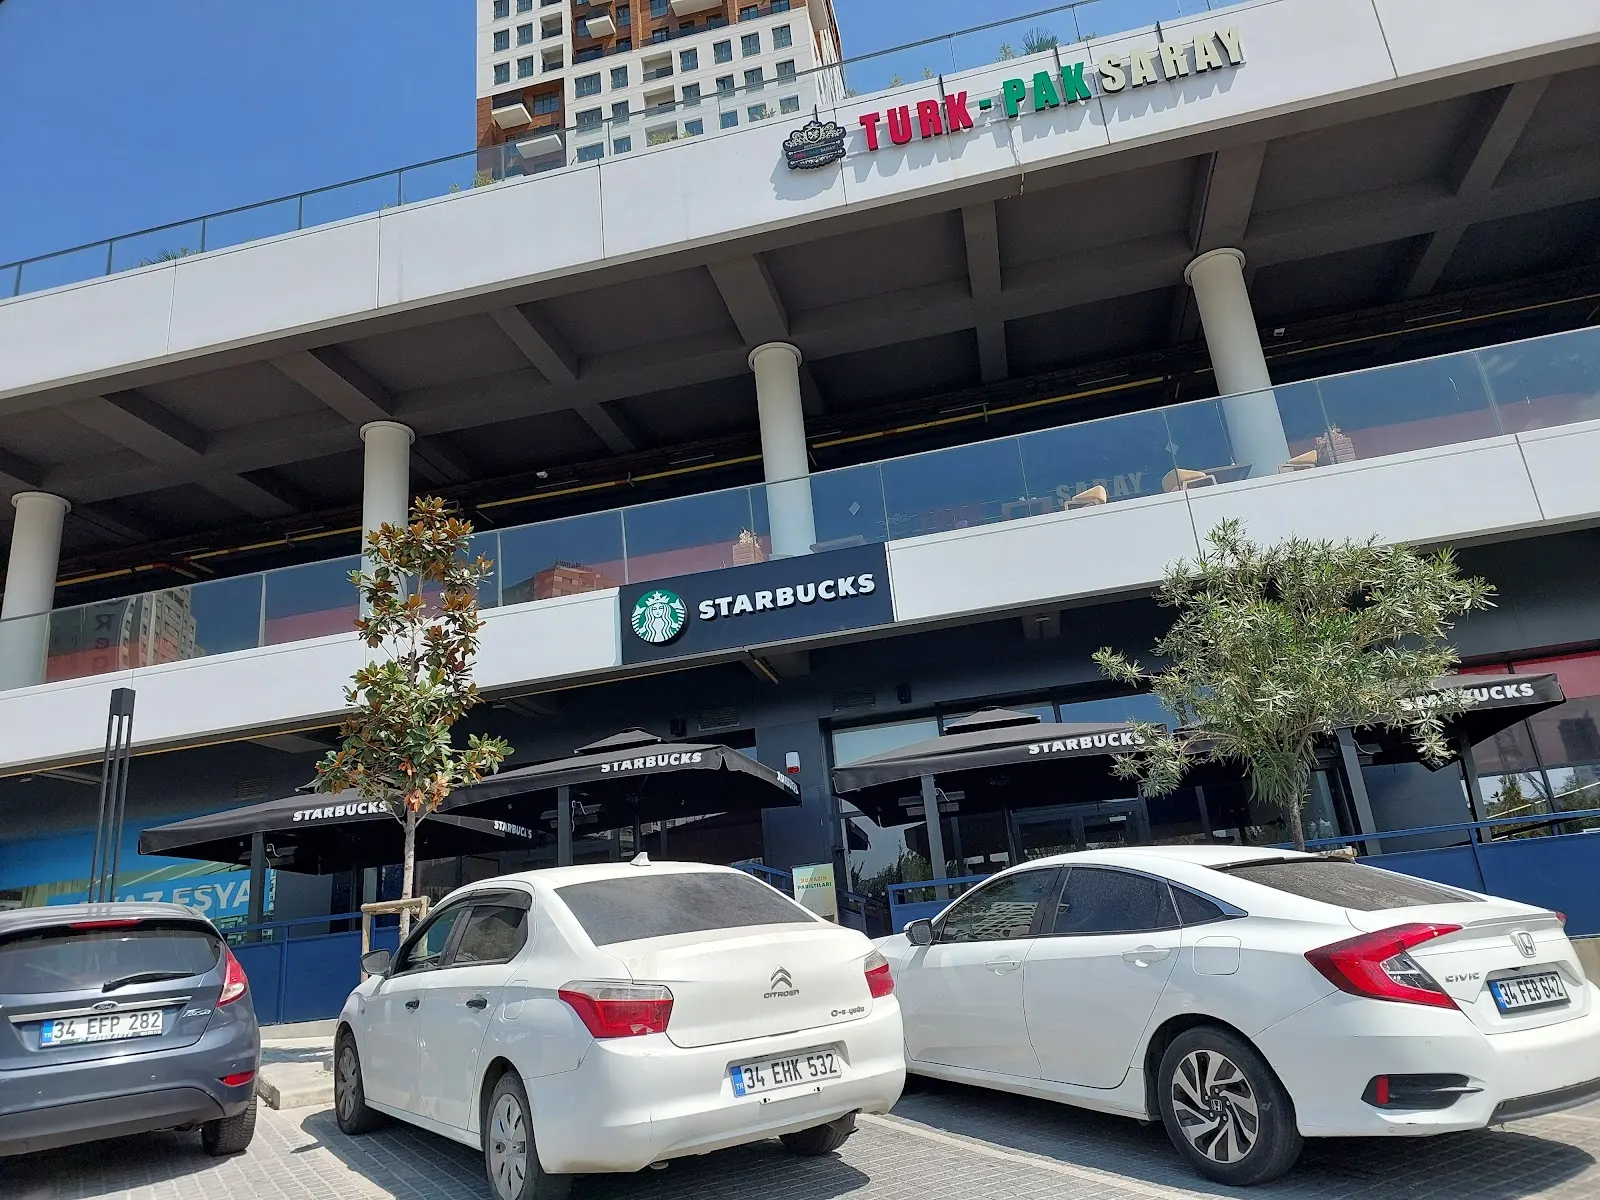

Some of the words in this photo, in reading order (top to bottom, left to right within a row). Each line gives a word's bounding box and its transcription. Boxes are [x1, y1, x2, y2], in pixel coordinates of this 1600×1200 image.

[859, 91, 974, 151] TURK
[1099, 26, 1242, 93] SARAY
[698, 573, 876, 620] STARBUCKS
[1028, 732, 1146, 755] STARBUCKS
[600, 752, 702, 773] STARBUCKS
[292, 801, 388, 821] STARBUCKS
[1445, 972, 1480, 983] CIVIC
[1500, 983, 1519, 1005] 34
[1516, 978, 1542, 1003] FEB
[1540, 976, 1563, 999] 642
[54, 1020, 76, 1040] 34
[87, 1016, 121, 1036] EFP
[128, 1012, 160, 1031] 282
[735, 1082, 745, 1091] TR
[744, 1066, 766, 1089] 34
[771, 1058, 803, 1085] EHK
[807, 1053, 838, 1077] 532
